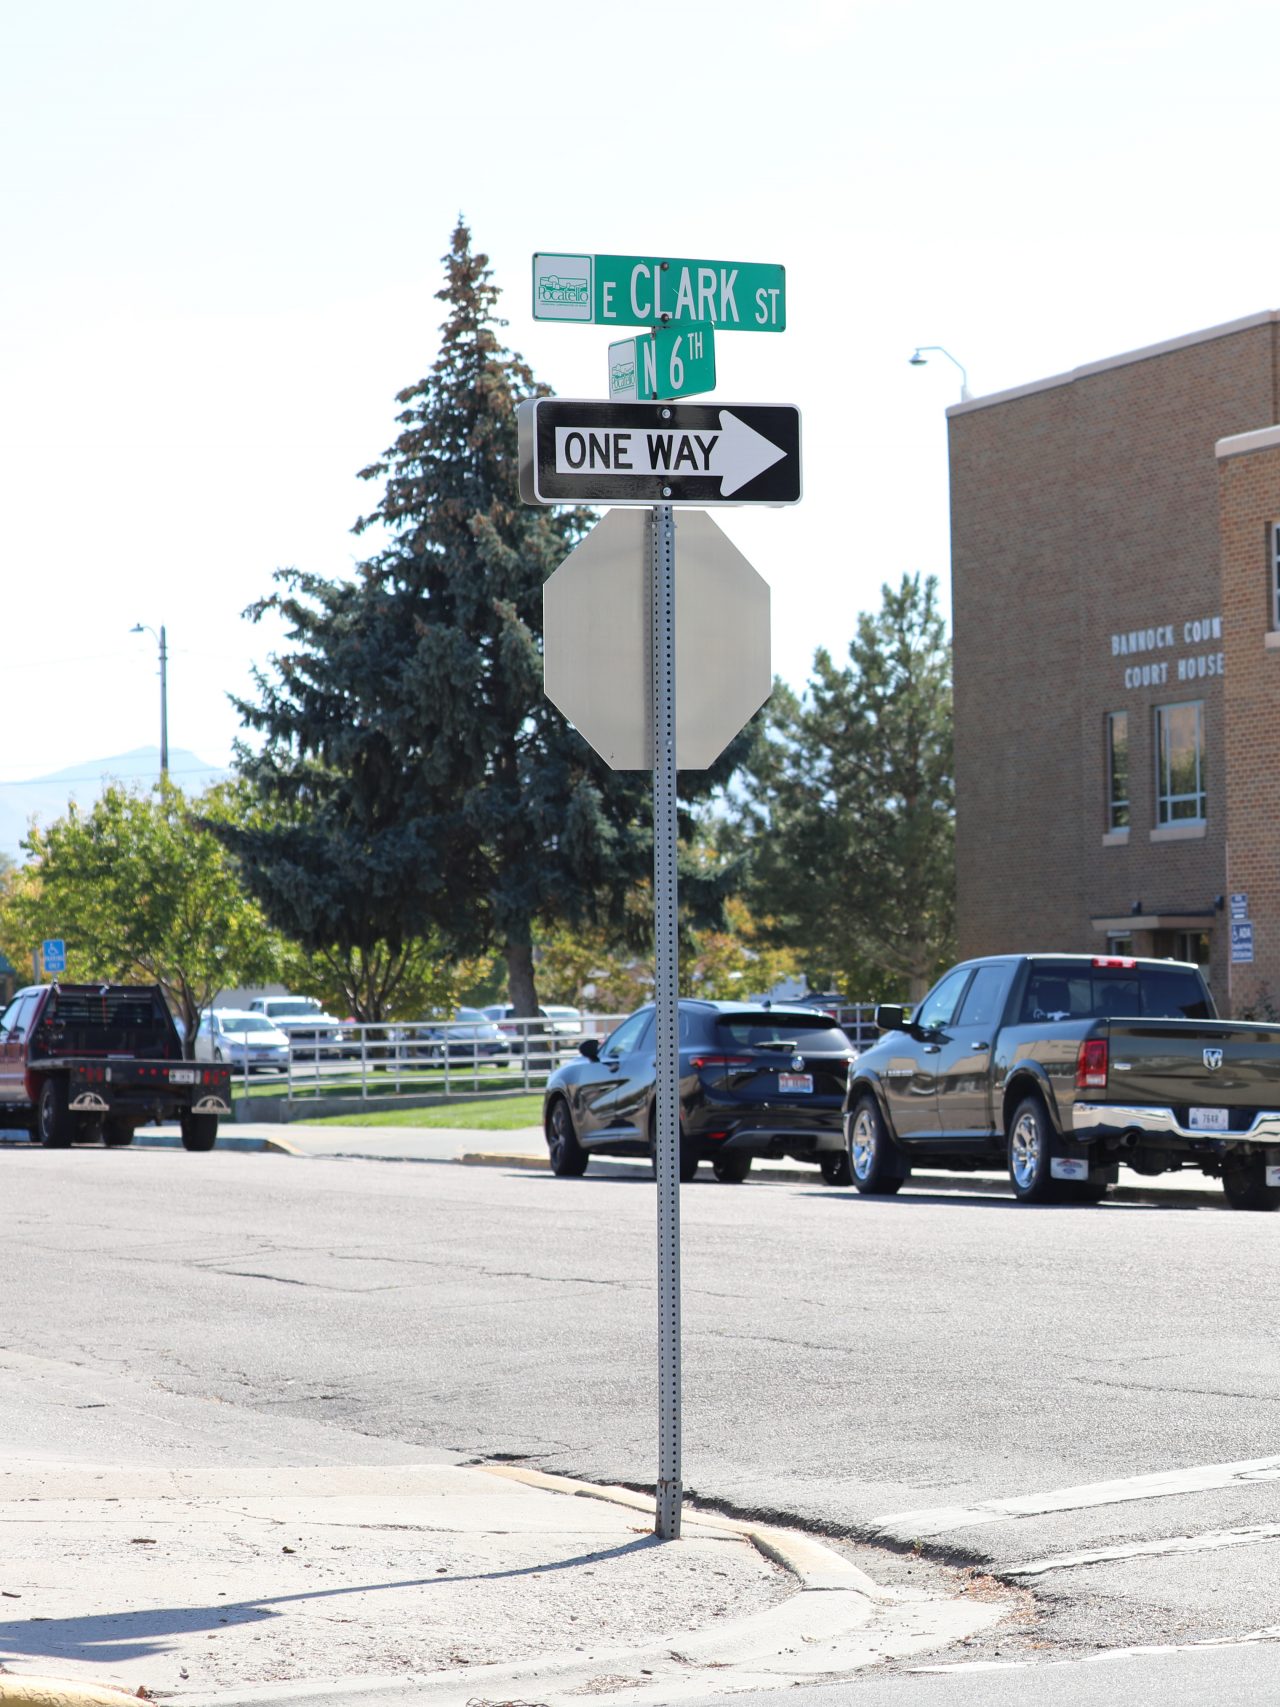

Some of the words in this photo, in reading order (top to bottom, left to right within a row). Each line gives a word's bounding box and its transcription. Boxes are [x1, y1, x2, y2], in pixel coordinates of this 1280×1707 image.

[538, 286, 588, 301] Pocatello
[602, 281, 617, 318] E
[630, 263, 740, 323] CLARK
[754, 288, 780, 324] ST
[643, 340, 657, 394] N
[564, 432, 633, 469] ONE
[646, 434, 719, 471] WAY
[1111, 624, 1174, 656] BANNOCK
[1125, 662, 1168, 689] COURT
[1177, 652, 1224, 681] HOUSE
